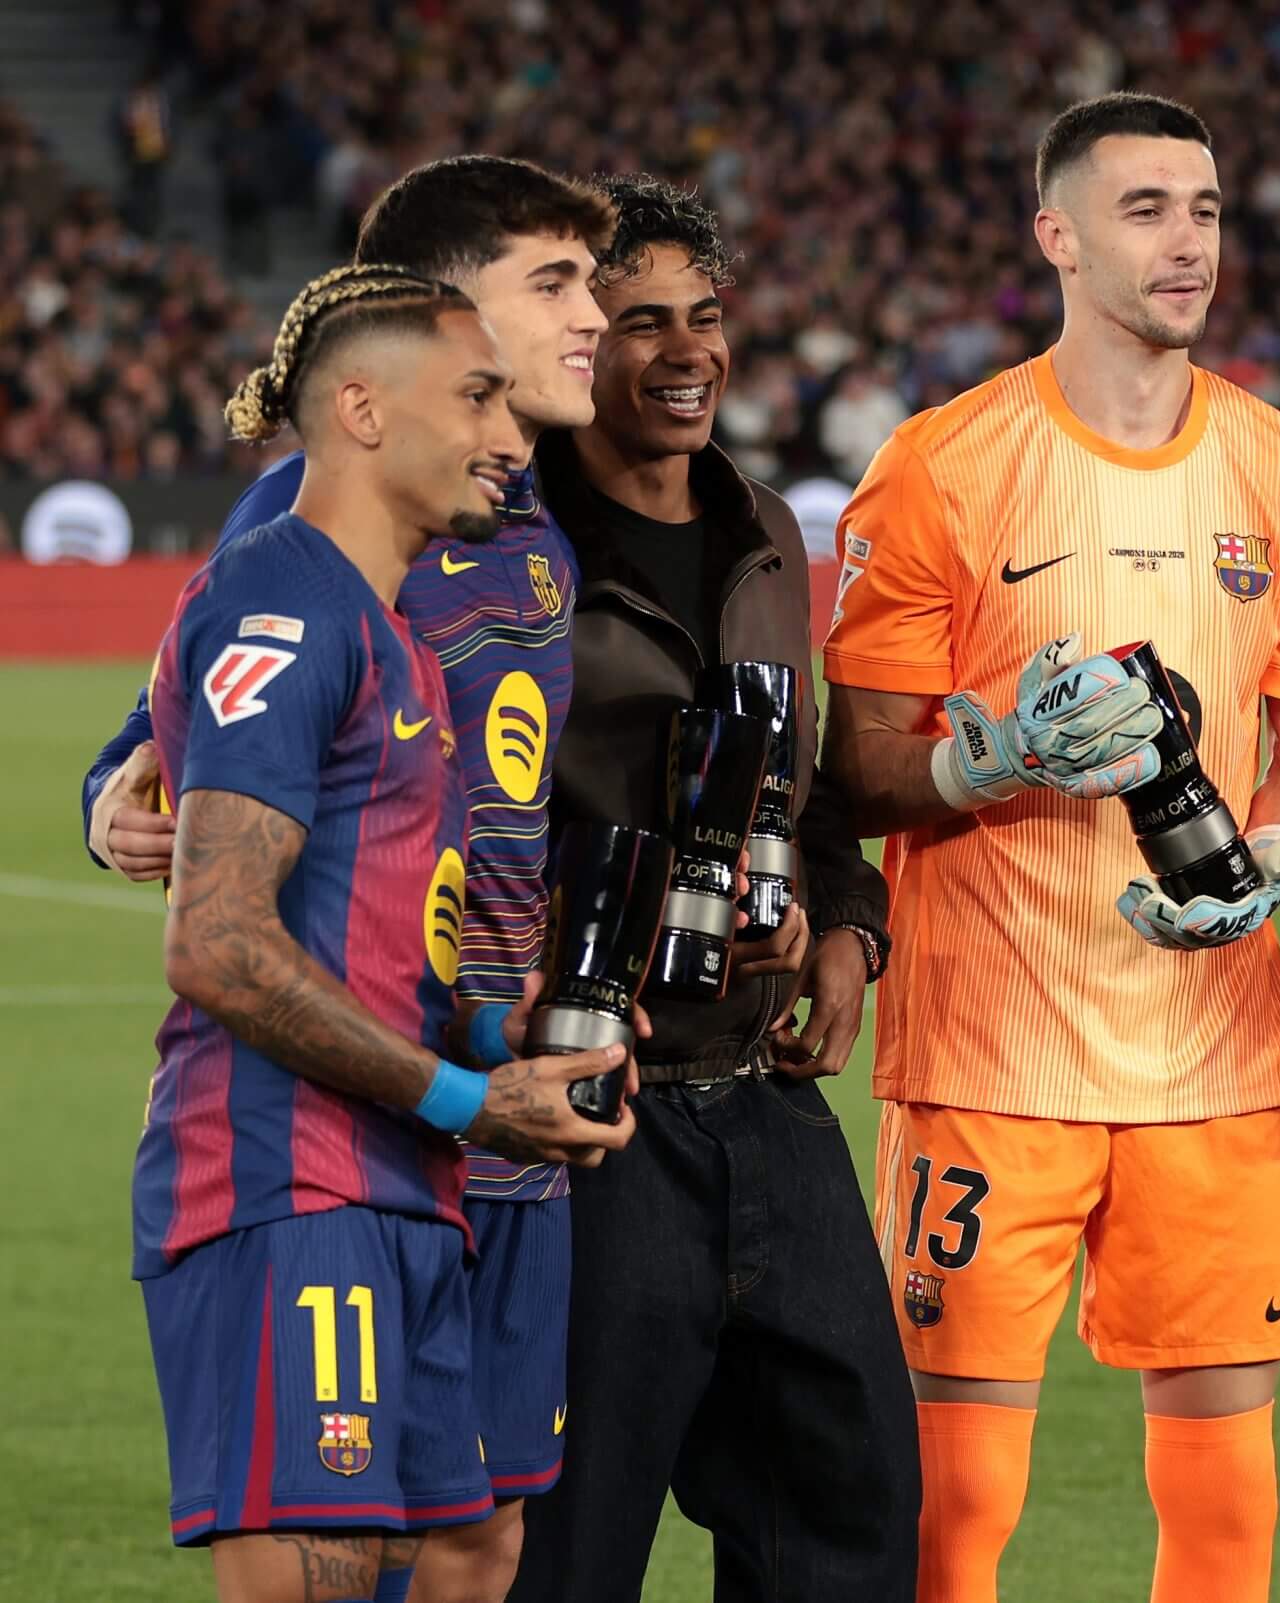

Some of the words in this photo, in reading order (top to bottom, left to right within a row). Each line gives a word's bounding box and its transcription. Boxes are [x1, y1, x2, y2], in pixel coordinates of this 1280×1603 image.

[971, 723, 988, 756] JOAN
[1168, 795, 1188, 816] OF
[687, 863, 709, 879] OF
[904, 1154, 992, 1271] 13
[296, 1285, 378, 1404] 11
